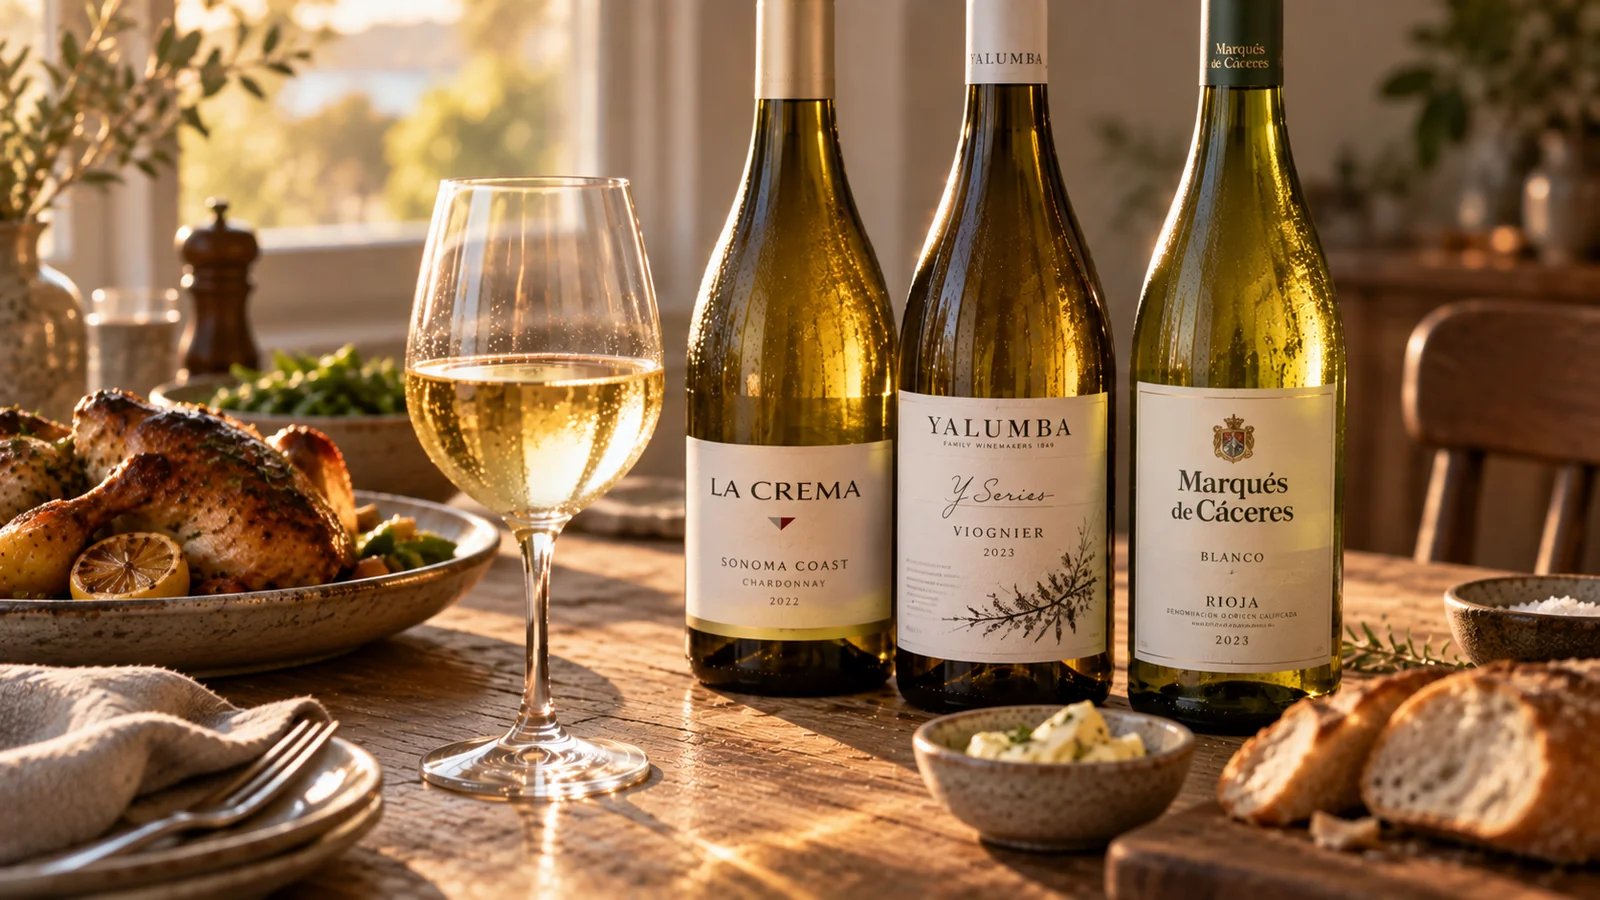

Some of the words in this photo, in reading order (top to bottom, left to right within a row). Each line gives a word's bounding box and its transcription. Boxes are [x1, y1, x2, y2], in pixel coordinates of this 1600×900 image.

[1215, 42, 1266, 58] Marqués
[1211, 58, 1222, 69] de
[927, 415, 1072, 438] YALUMBA
[943, 440, 971, 448] FAMILY
[975, 442, 1033, 450] WINEMAKERS
[711, 477, 741, 499] LA
[750, 480, 861, 501] CREMA
[973, 477, 1055, 503] Series
[1177, 469, 1288, 500] Marqués
[1171, 501, 1193, 520] de
[1196, 498, 1294, 523] Cáceres
[953, 525, 1044, 539] VIOGNIER
[983, 548, 1015, 558] 2023
[1200, 551, 1265, 563] BLANCO
[721, 556, 787, 572] SONOMA
[795, 558, 849, 572] COAST
[742, 577, 826, 588] CHARDONNAY
[769, 596, 799, 606] 2022
[1205, 595, 1259, 609] RIOJA
[1215, 635, 1249, 646] 2023
